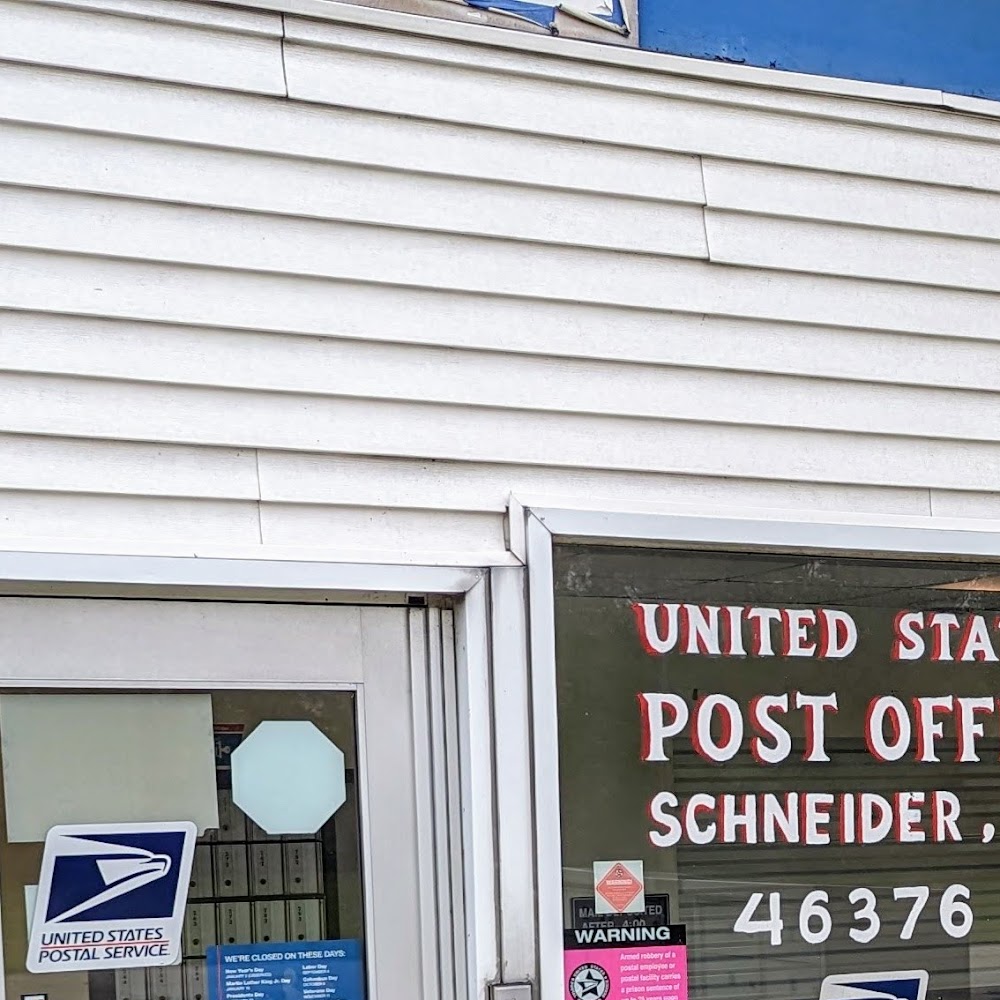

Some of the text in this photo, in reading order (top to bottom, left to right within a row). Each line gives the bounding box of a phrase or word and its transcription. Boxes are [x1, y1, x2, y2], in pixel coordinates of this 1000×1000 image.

[632, 602, 858, 658] UNITED
[640, 691, 839, 763] POST
[734, 884, 974, 945] 46376
[41, 927, 163, 946] UNITED STATES
[574, 926, 671, 944] WARNING
[38, 943, 169, 963] POSTAL SERVICE
[225, 949, 346, 963] WE'RE CLOSED ON THESE DAYS:
[641, 952, 663, 960] robbery
[620, 975, 638, 983] postal
[640, 974, 659, 982] facility
[626, 986, 645, 994] prison
[646, 984, 672, 992] sentence
